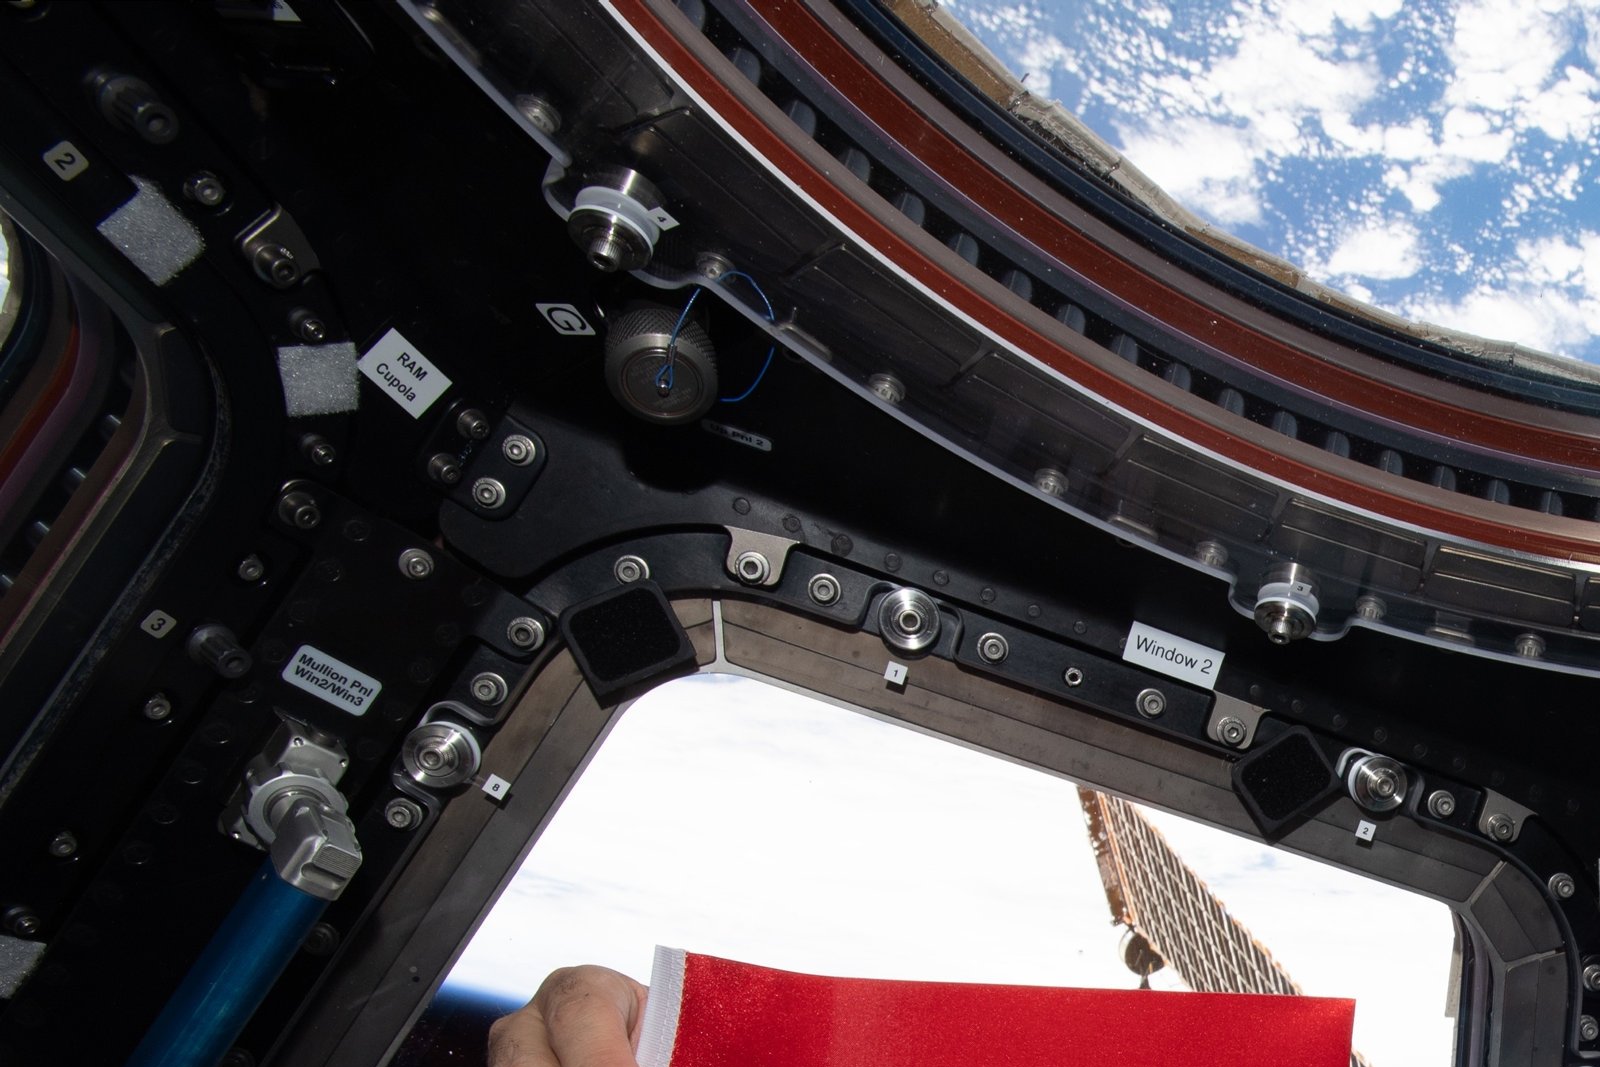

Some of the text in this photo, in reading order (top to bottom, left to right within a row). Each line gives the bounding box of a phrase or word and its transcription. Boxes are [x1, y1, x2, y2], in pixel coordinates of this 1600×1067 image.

[55, 152, 75, 171] 2
[547, 307, 587, 331] G
[397, 350, 428, 382] RAM
[375, 361, 417, 403] Cupola
[755, 438, 764, 447] 2
[151, 618, 166, 631] 3
[1136, 634, 1213, 675] Window 2
[294, 664, 365, 708] Win2/Win3
[299, 653, 374, 698] Mullion Pnl
[492, 783, 500, 792] 8
